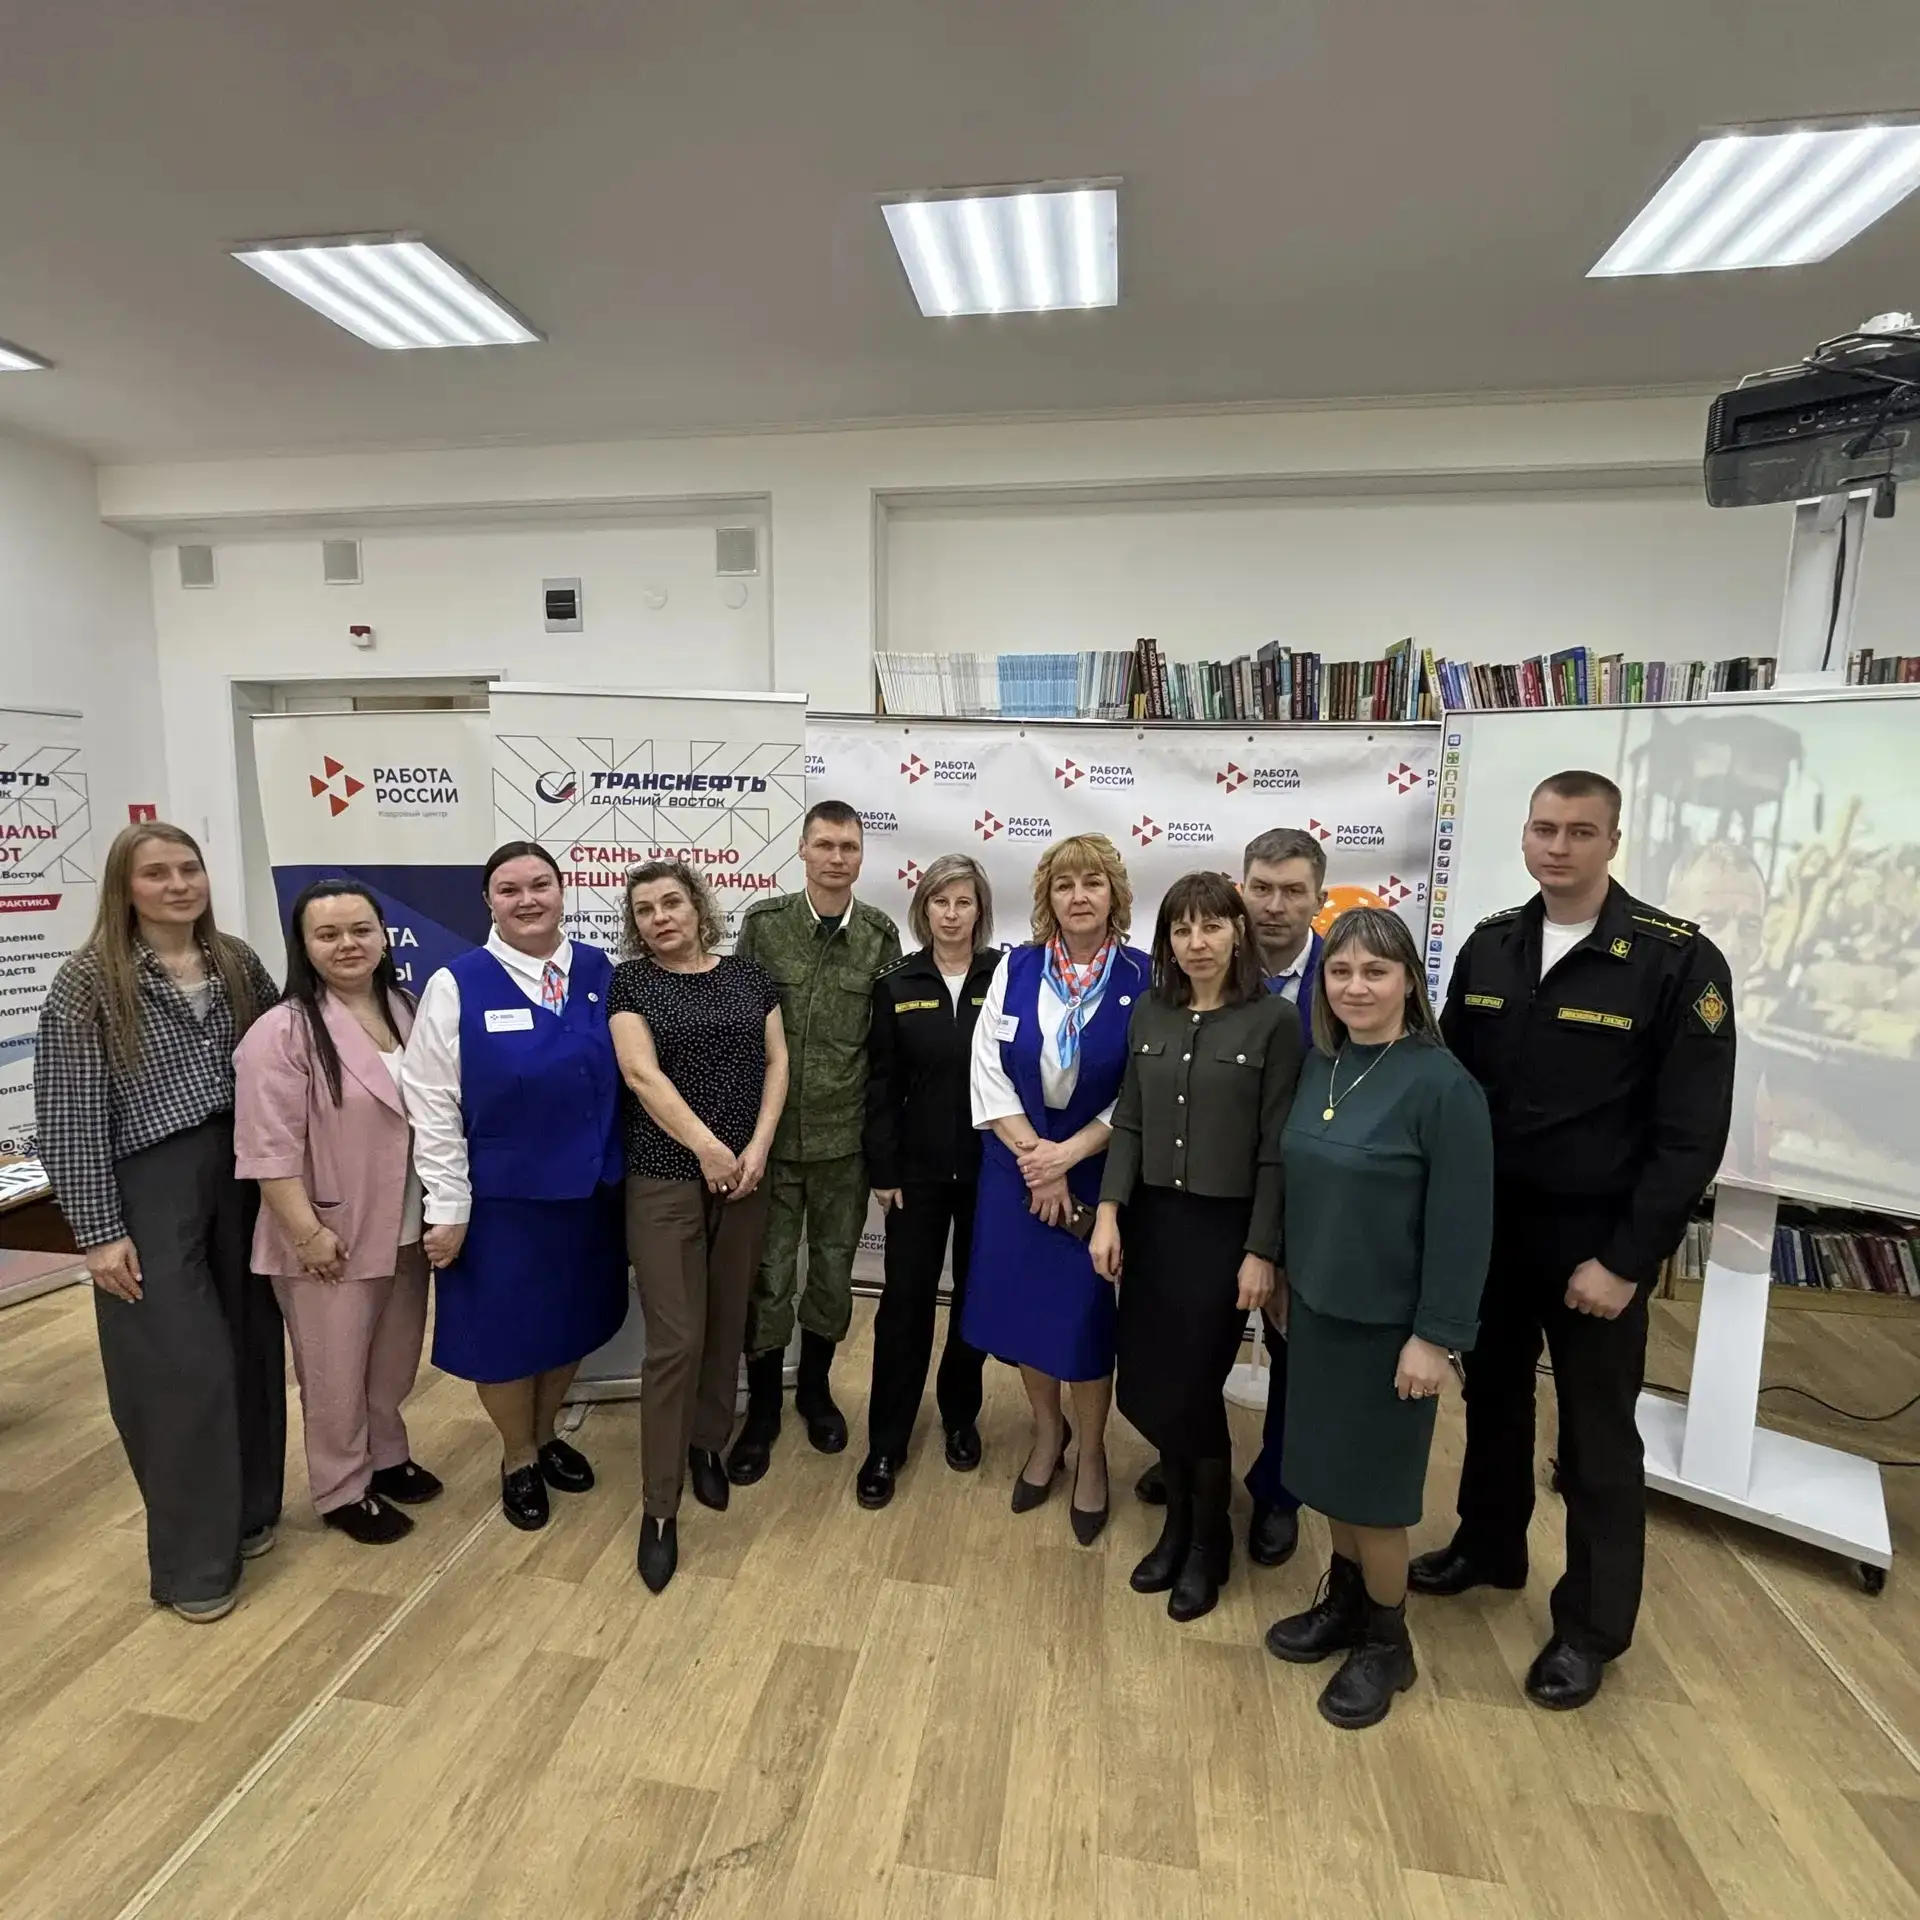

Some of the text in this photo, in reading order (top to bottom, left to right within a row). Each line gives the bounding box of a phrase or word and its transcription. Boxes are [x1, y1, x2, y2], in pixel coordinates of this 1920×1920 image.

[934, 760, 976, 770] РАБОТА
[1090, 765, 1133, 775] РАБОТА
[373, 768, 453, 784] РАБОТА
[934, 771, 977, 781] РОССИИ
[1253, 768, 1299, 778] РАБОТА
[590, 772, 767, 793] ТРАНСНЕФТЬ
[1089, 776, 1135, 786] РОССИИ
[1253, 779, 1301, 789] РОССИИ
[376, 787, 460, 804] РОССИИ
[590, 793, 726, 808] ДАЛЬНИЙ ВОСТОК
[863, 821, 899, 831] ОССИИ
[1008, 817, 1051, 827] РАБОТА
[1168, 822, 1212, 832] РАБОТА
[1008, 827, 1052, 837] РОССИИ
[1336, 824, 1383, 835] РАБОТА
[1167, 832, 1214, 842] РОССИИ
[1336, 835, 1385, 846] РОССИИ
[570, 846, 642, 863] СТАНЬ
[0, 949, 74, 963] ологически
